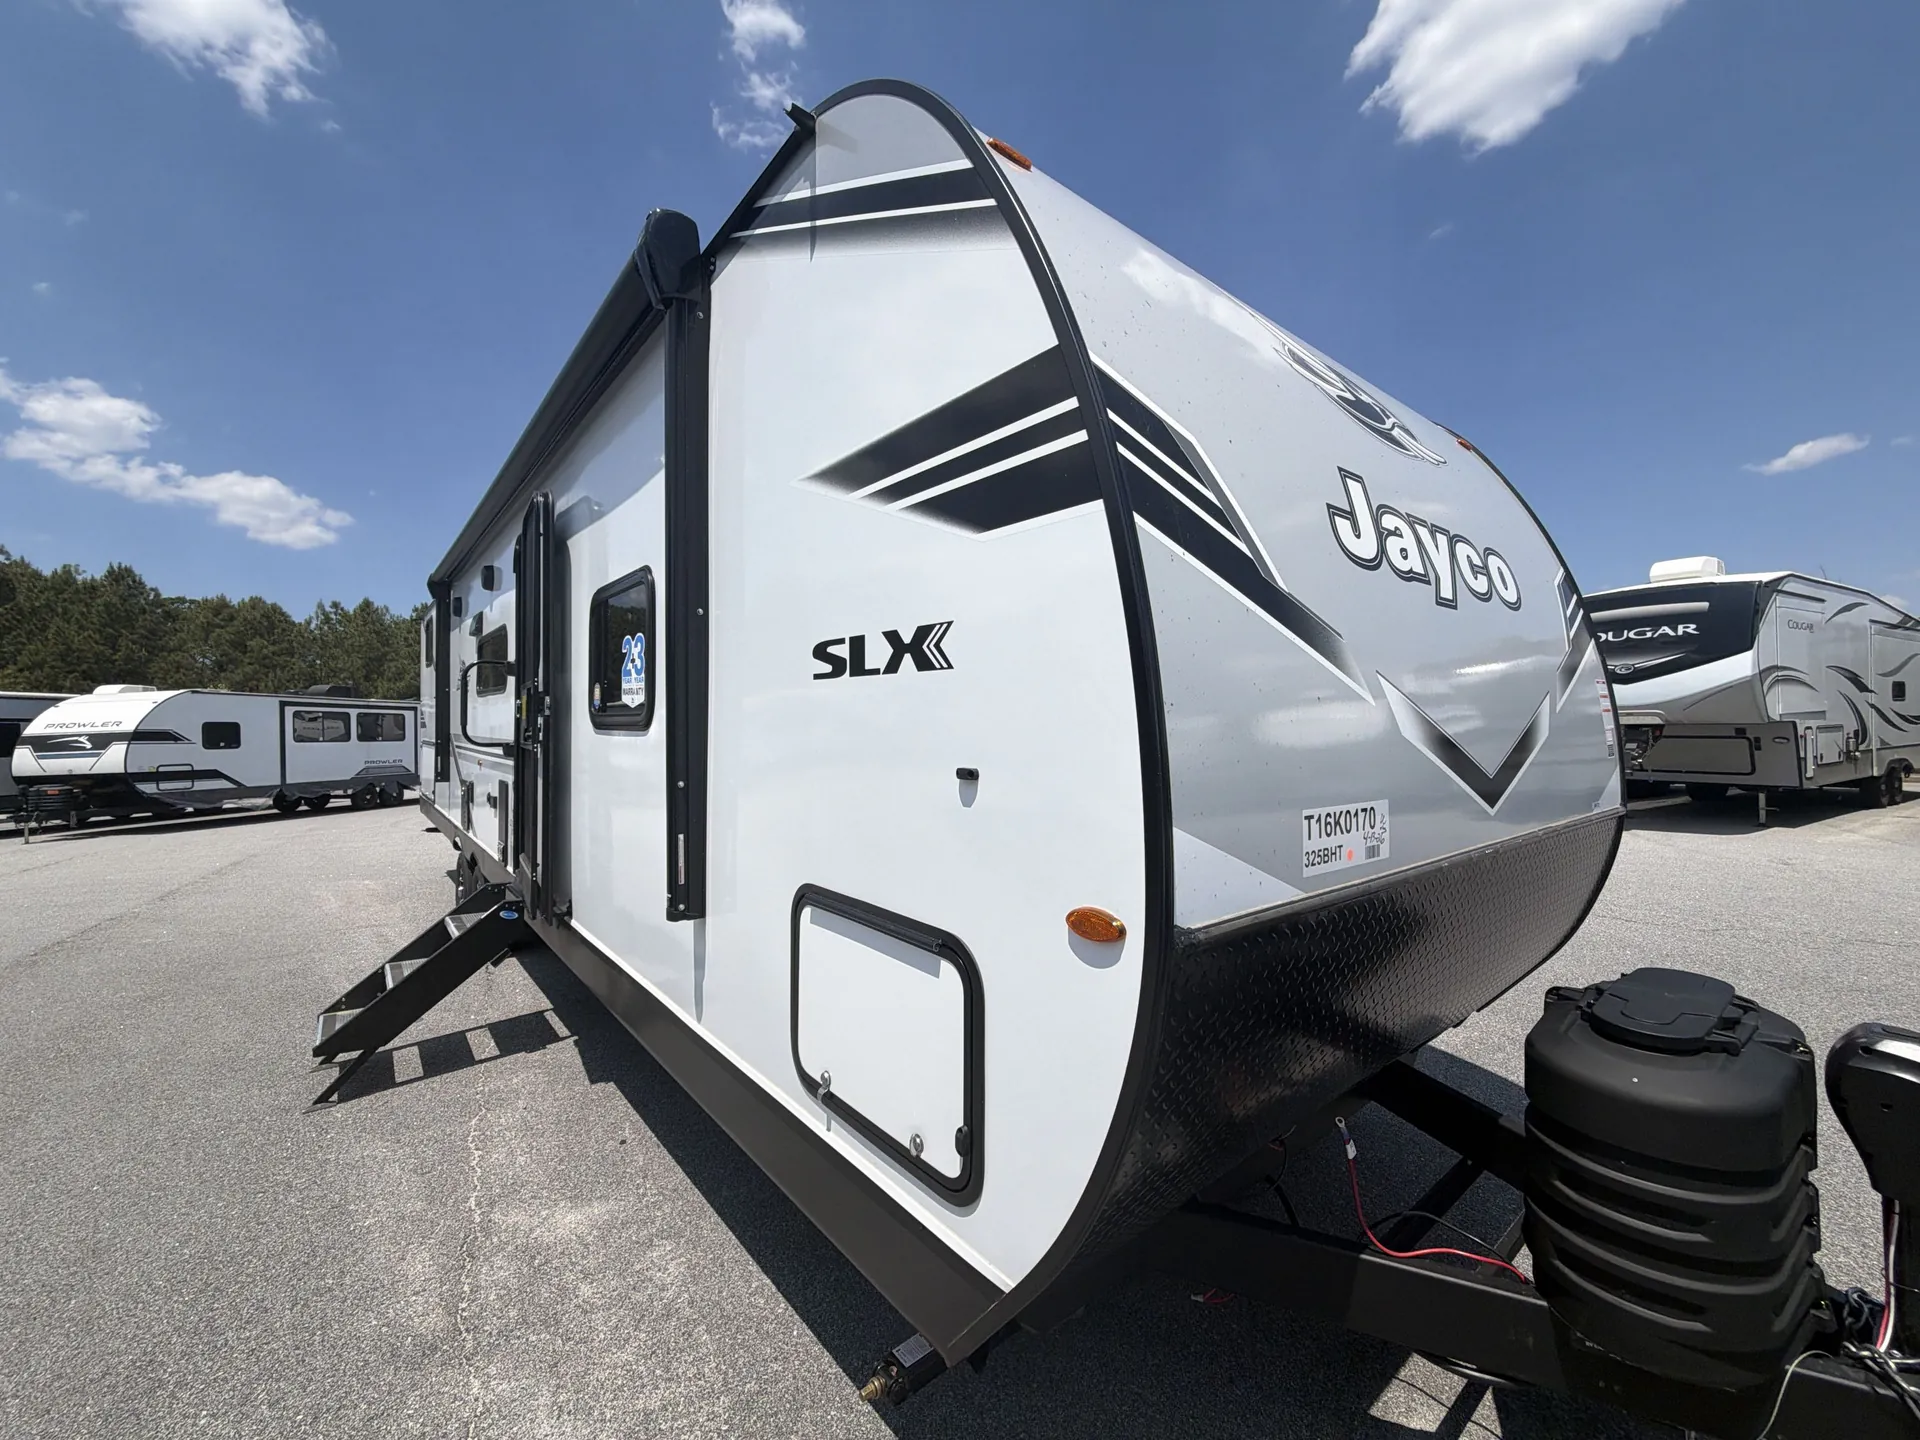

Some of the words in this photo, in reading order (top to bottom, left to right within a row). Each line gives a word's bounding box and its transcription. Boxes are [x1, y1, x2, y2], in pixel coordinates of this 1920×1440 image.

[1326, 465, 1521, 611] Jayco
[1597, 624, 1699, 642] UGAR
[812, 620, 954, 680] SLX
[44, 721, 122, 730] PROWLER
[1304, 806, 1376, 841] T16K0170
[1304, 845, 1343, 868] 325BHT
